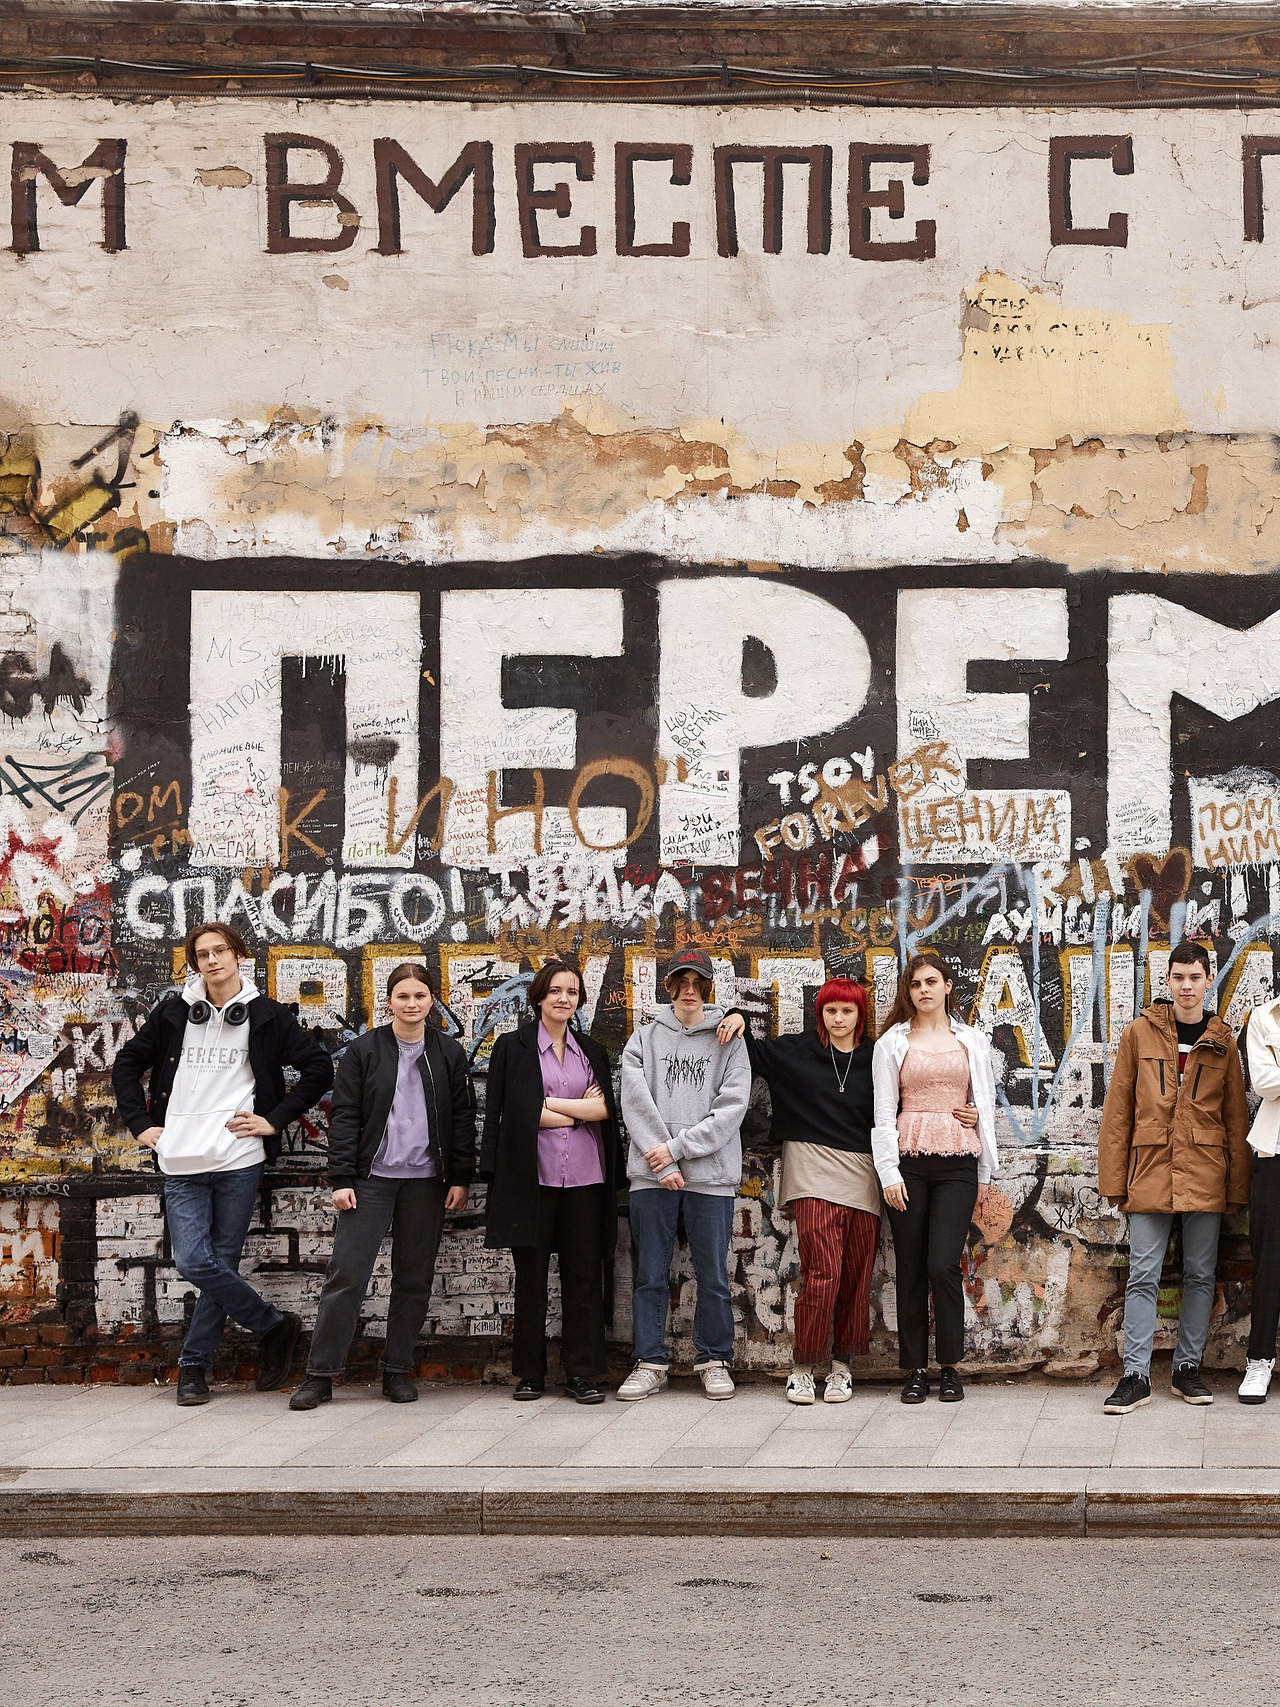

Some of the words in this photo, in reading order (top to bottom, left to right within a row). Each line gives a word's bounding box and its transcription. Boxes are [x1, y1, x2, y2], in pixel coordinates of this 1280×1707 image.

[264, 133, 936, 261] ВМЕСТЕ
[1050, 135, 1134, 247] С
[485, 364, 540, 383] ПЕСНИ
[585, 360, 622, 376] ЖИВ
[901, 796, 1060, 861] ЦЕНИМ
[1199, 798, 1274, 842] ПОМ
[124, 868, 466, 947] СПАСИБО!
[181, 1047, 248, 1065] PERFECT
